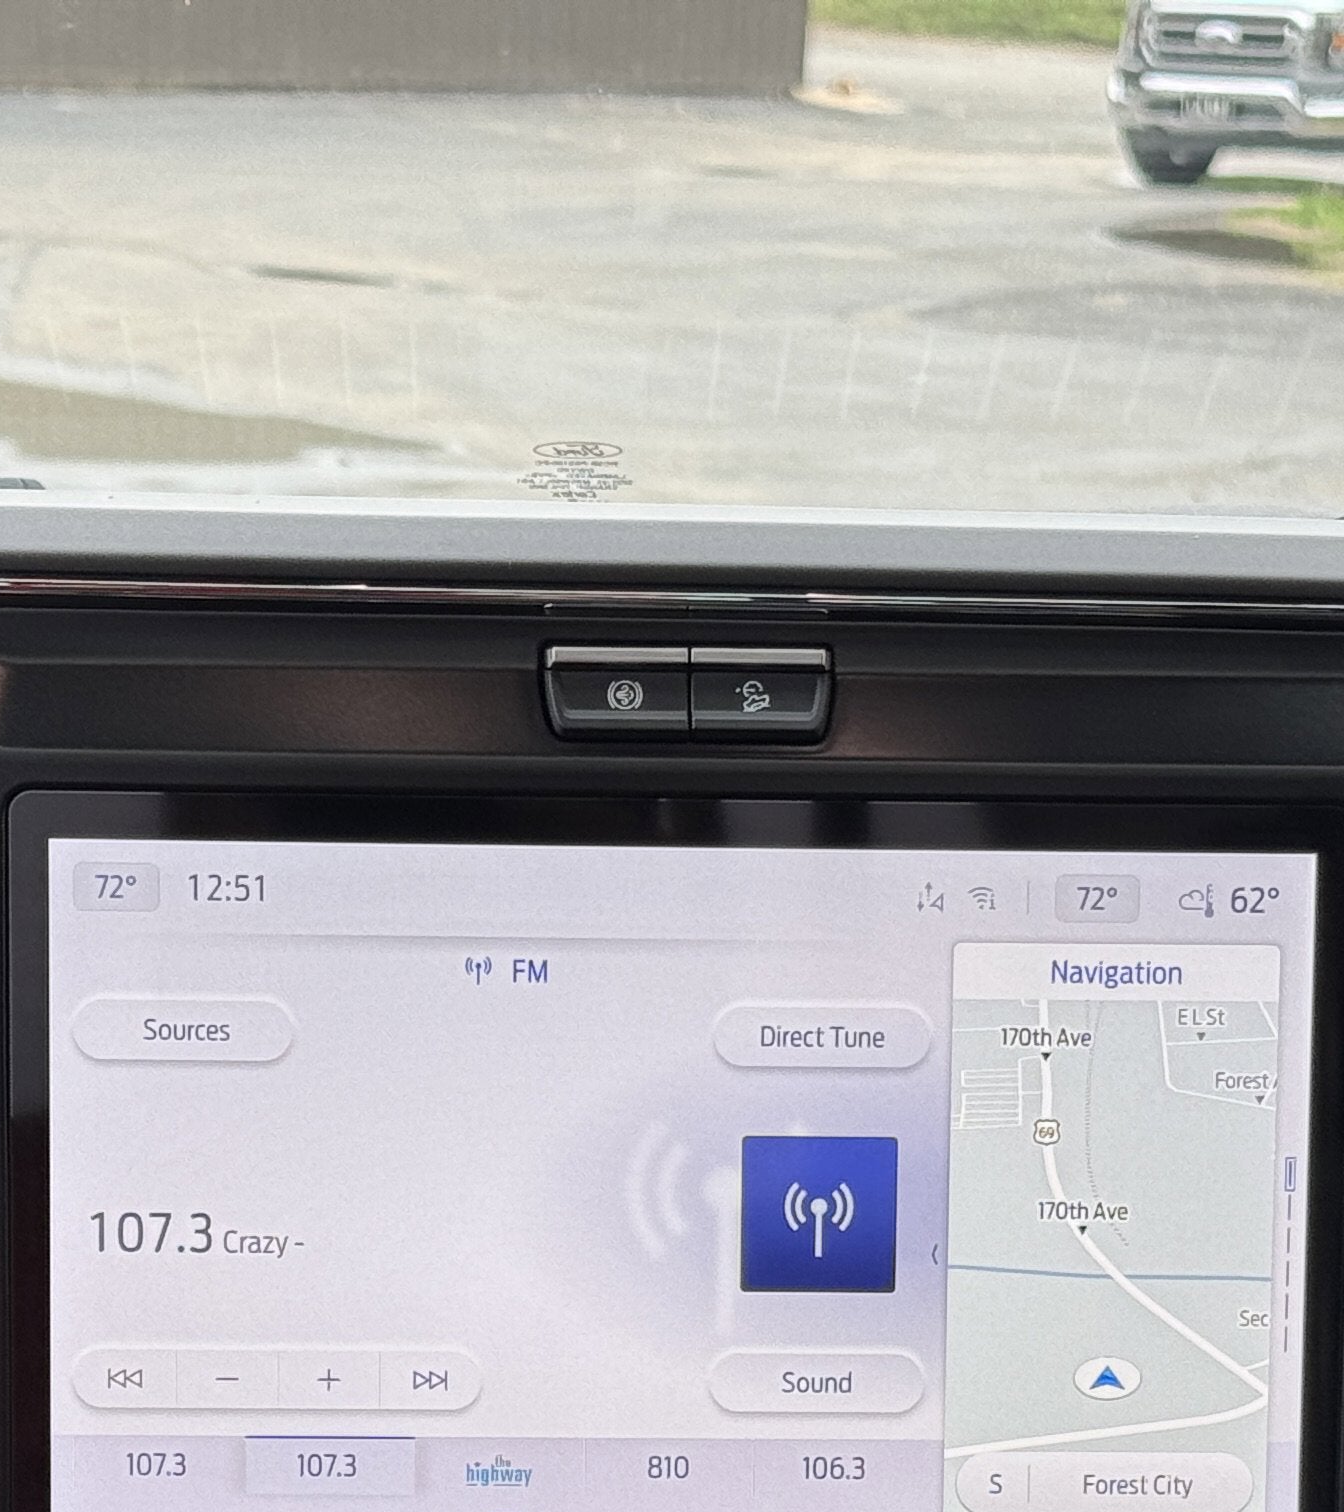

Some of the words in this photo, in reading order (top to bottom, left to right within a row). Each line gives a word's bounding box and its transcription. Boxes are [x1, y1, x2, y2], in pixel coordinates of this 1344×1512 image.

[94, 874, 137, 899] 72°
[188, 873, 265, 902] 12:51
[1076, 886, 1118, 911] 72°
[1230, 886, 1280, 914] 62°
[512, 958, 548, 983] FM
[1051, 959, 1183, 990] Navigation
[1203, 1007, 1225, 1027] St
[143, 1018, 231, 1042] Sources
[760, 1025, 825, 1048] Direct
[829, 1025, 885, 1049] Tune
[1001, 1027, 1052, 1047] 170th
[1056, 1027, 1092, 1048] Ave
[1214, 1071, 1269, 1090] Forest
[1036, 1126, 1055, 1139] 69
[1038, 1201, 1089, 1220] 170th
[1092, 1201, 1129, 1221] Ave
[90, 1211, 213, 1254] 107.3
[223, 1229, 289, 1259] Crazy
[1239, 1309, 1269, 1328] Sec
[781, 1370, 853, 1394] Sound
[126, 1452, 187, 1477] 107.3
[297, 1453, 357, 1478] 107.3
[465, 1461, 533, 1487] highway
[647, 1455, 690, 1479] 810
[802, 1456, 865, 1480] 106.3
[988, 1473, 1003, 1495] S
[1083, 1474, 1148, 1496] Forest
[1153, 1474, 1193, 1499] City
